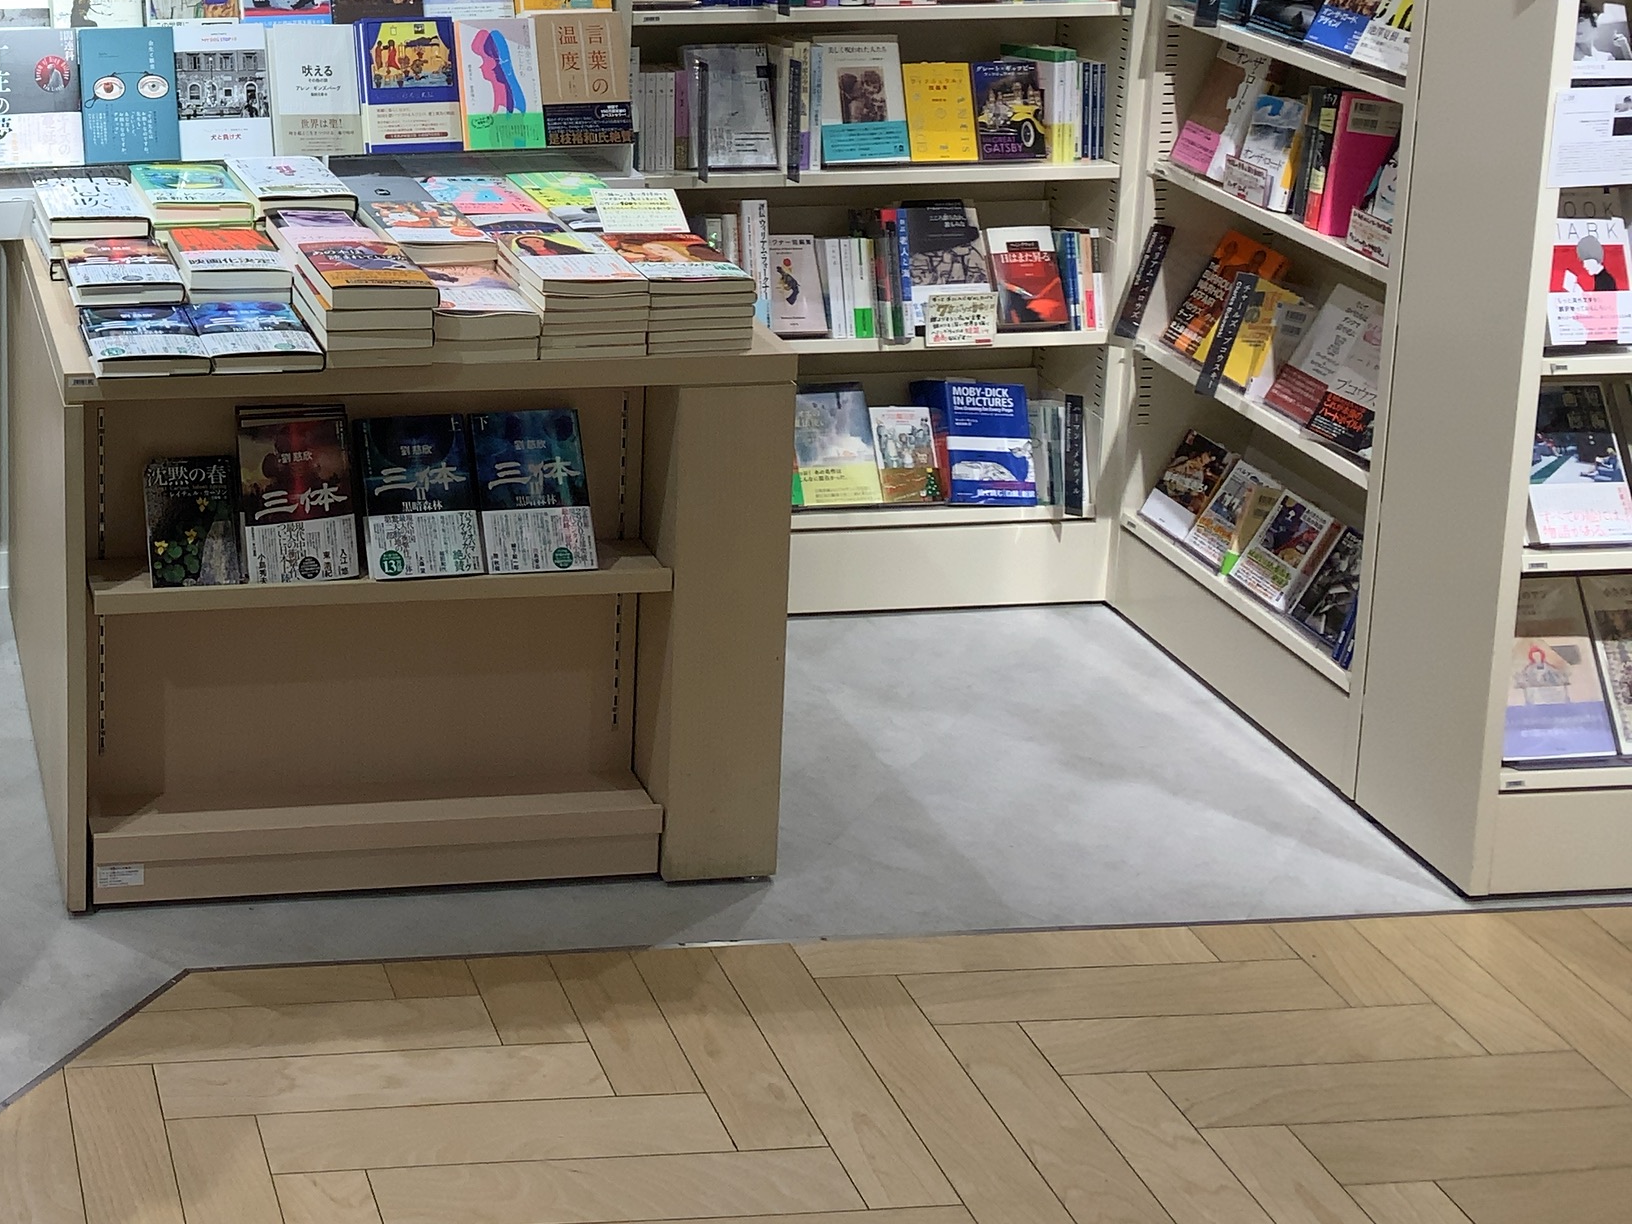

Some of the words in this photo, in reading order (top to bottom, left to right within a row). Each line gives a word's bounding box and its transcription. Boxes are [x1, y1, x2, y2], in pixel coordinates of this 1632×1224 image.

[557, 25, 582, 73] 温度
[585, 23, 609, 96] 言葉の
[301, 64, 334, 77] 吠える
[209, 132, 243, 141] 犬と負け犬
[983, 142, 1024, 154] GATSBY
[188, 257, 276, 266] 映画化決定!
[952, 386, 1010, 399] MOBY-DICK
[953, 396, 965, 408] IN
[966, 395, 1015, 408] PICTURES
[449, 416, 462, 432] 上
[475, 416, 489, 432] 下
[399, 444, 433, 456] 劉慈欣
[513, 439, 547, 451] 劉慈欣
[280, 450, 313, 464] 劉慈欣
[147, 464, 227, 488] 沈黙の春
[374, 461, 467, 496] 三体
[487, 455, 581, 491] 三体
[168, 489, 228, 498] レイチェル・カーソン
[254, 482, 348, 521] 三体
[401, 500, 443, 513] 黒暗森林
[515, 494, 558, 507] 黒暗森林
